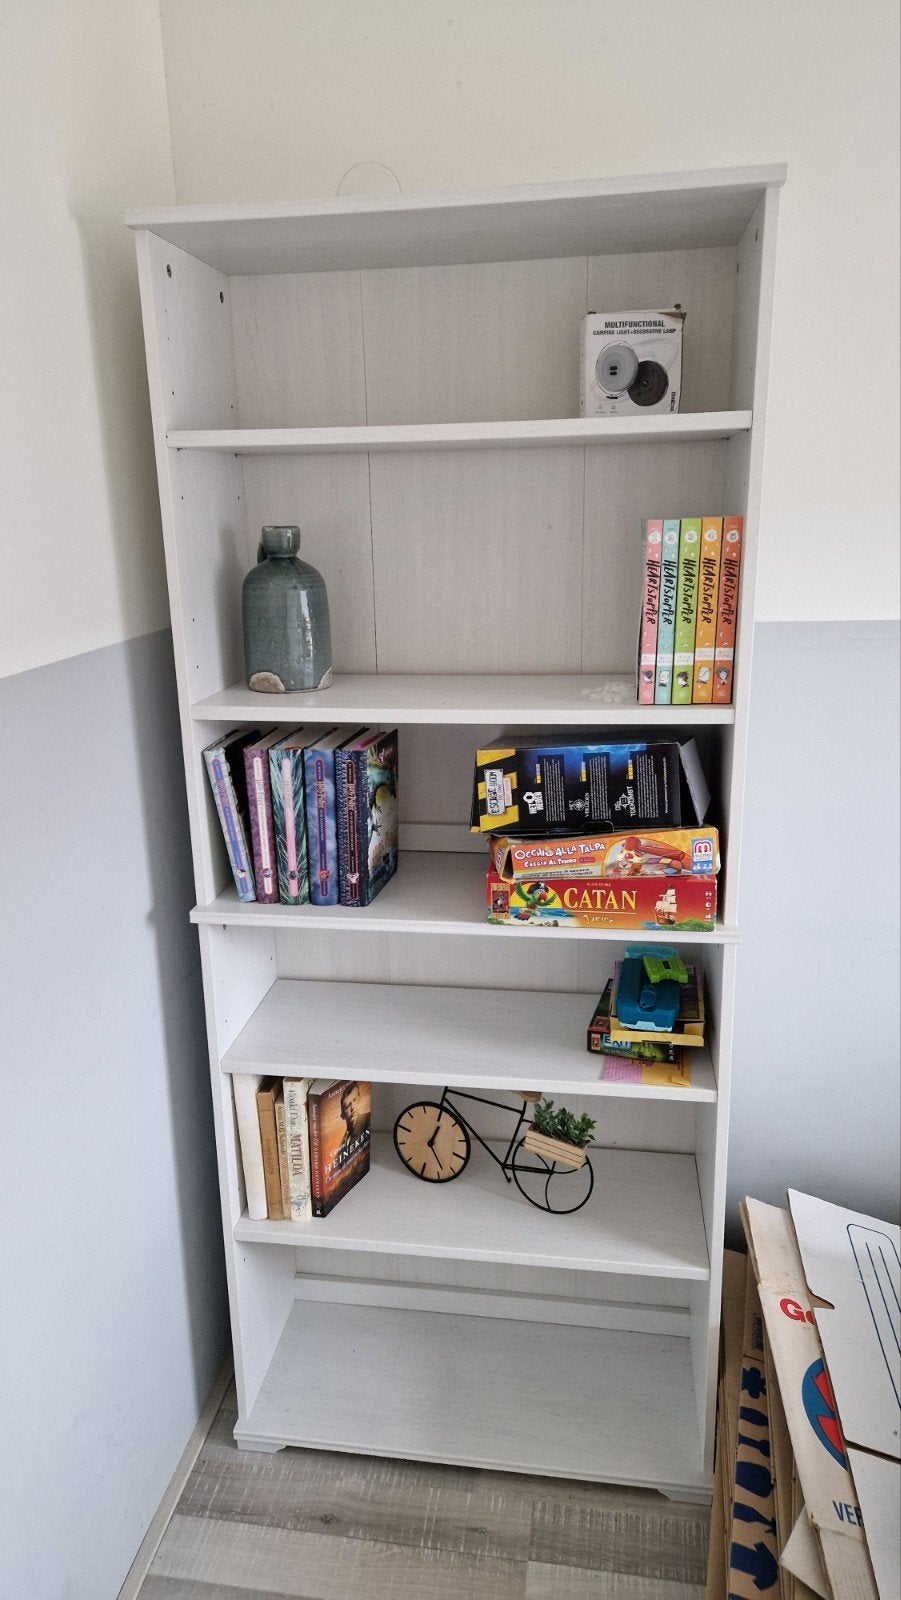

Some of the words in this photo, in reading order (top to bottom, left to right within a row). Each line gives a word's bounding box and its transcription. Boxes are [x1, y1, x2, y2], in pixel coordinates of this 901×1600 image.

[604, 320, 666, 329] MULTIFUNCTIONAL
[645, 559, 660, 625] HEARTSTOPPER
[662, 559, 677, 626] HEARTSTOPPER
[681, 558, 696, 624] HEARTSTOPPER
[702, 557, 716, 624] HEARTSTOPPER
[722, 558, 738, 625] HEARTSTOPPER
[626, 786, 636, 818] TOEKOMST
[555, 846, 577, 856] ALLA
[578, 843, 606, 854] TALPA
[564, 888, 638, 910] CATAN
[290, 1132, 302, 1176] MATILDA
